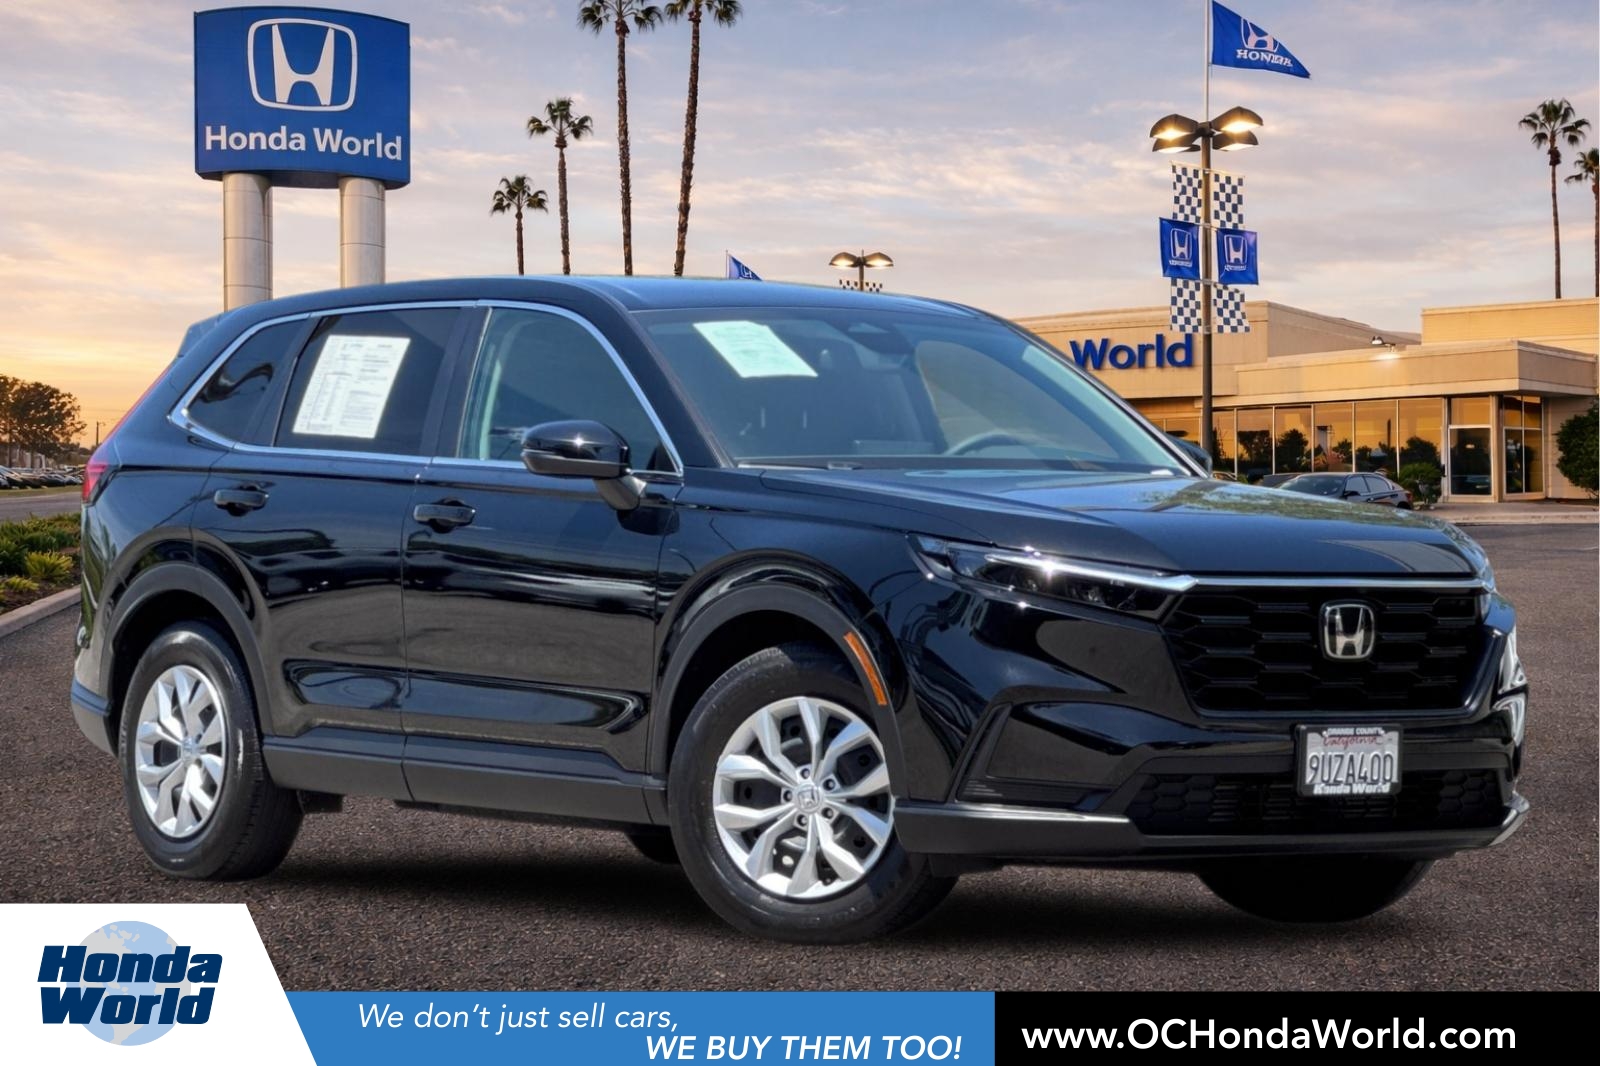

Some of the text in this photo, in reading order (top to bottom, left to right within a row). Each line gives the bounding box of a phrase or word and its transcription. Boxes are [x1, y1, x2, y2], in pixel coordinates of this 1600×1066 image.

[205, 125, 402, 160] Honda World
[1069, 333, 1194, 370] World
[1306, 752, 1394, 784] 9UZA400
